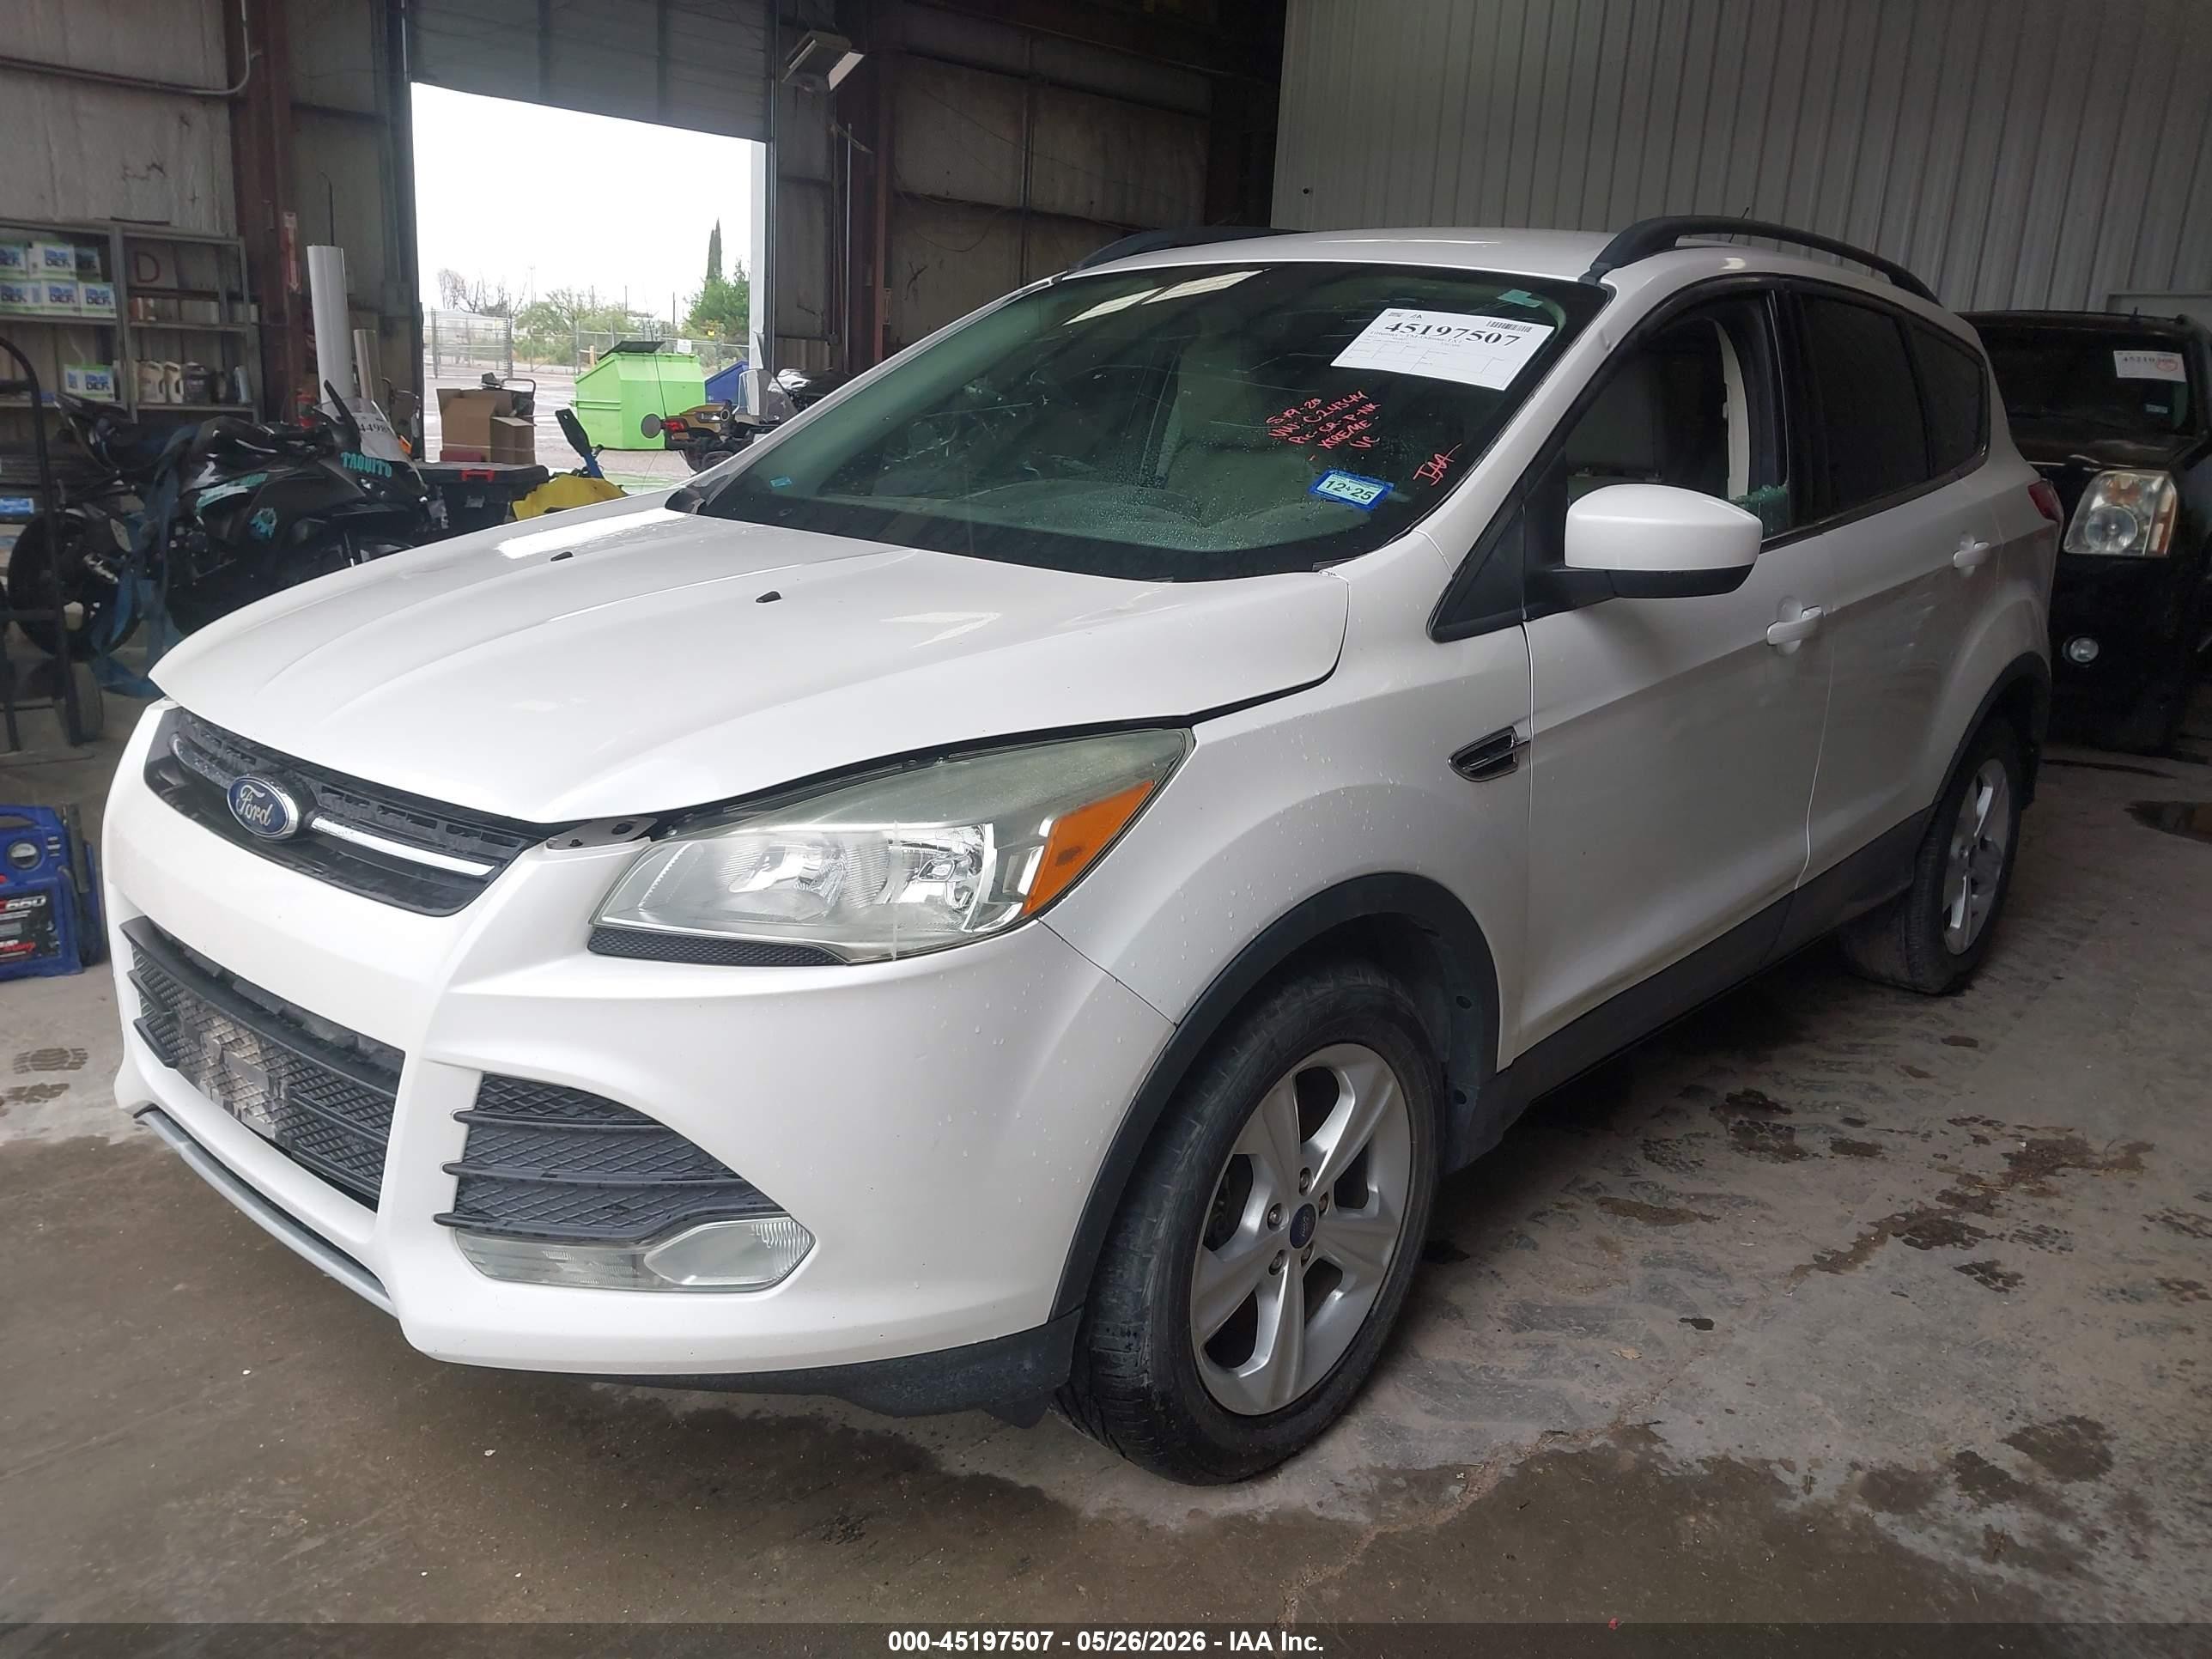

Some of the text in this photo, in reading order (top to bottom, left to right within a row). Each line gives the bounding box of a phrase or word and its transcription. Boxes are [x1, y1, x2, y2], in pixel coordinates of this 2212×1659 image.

[1384, 321, 1522, 347] 45197507
[1317, 420, 1372, 450] XTREME
[340, 451, 392, 478] TAQUITO
[235, 784, 274, 827] Ford
